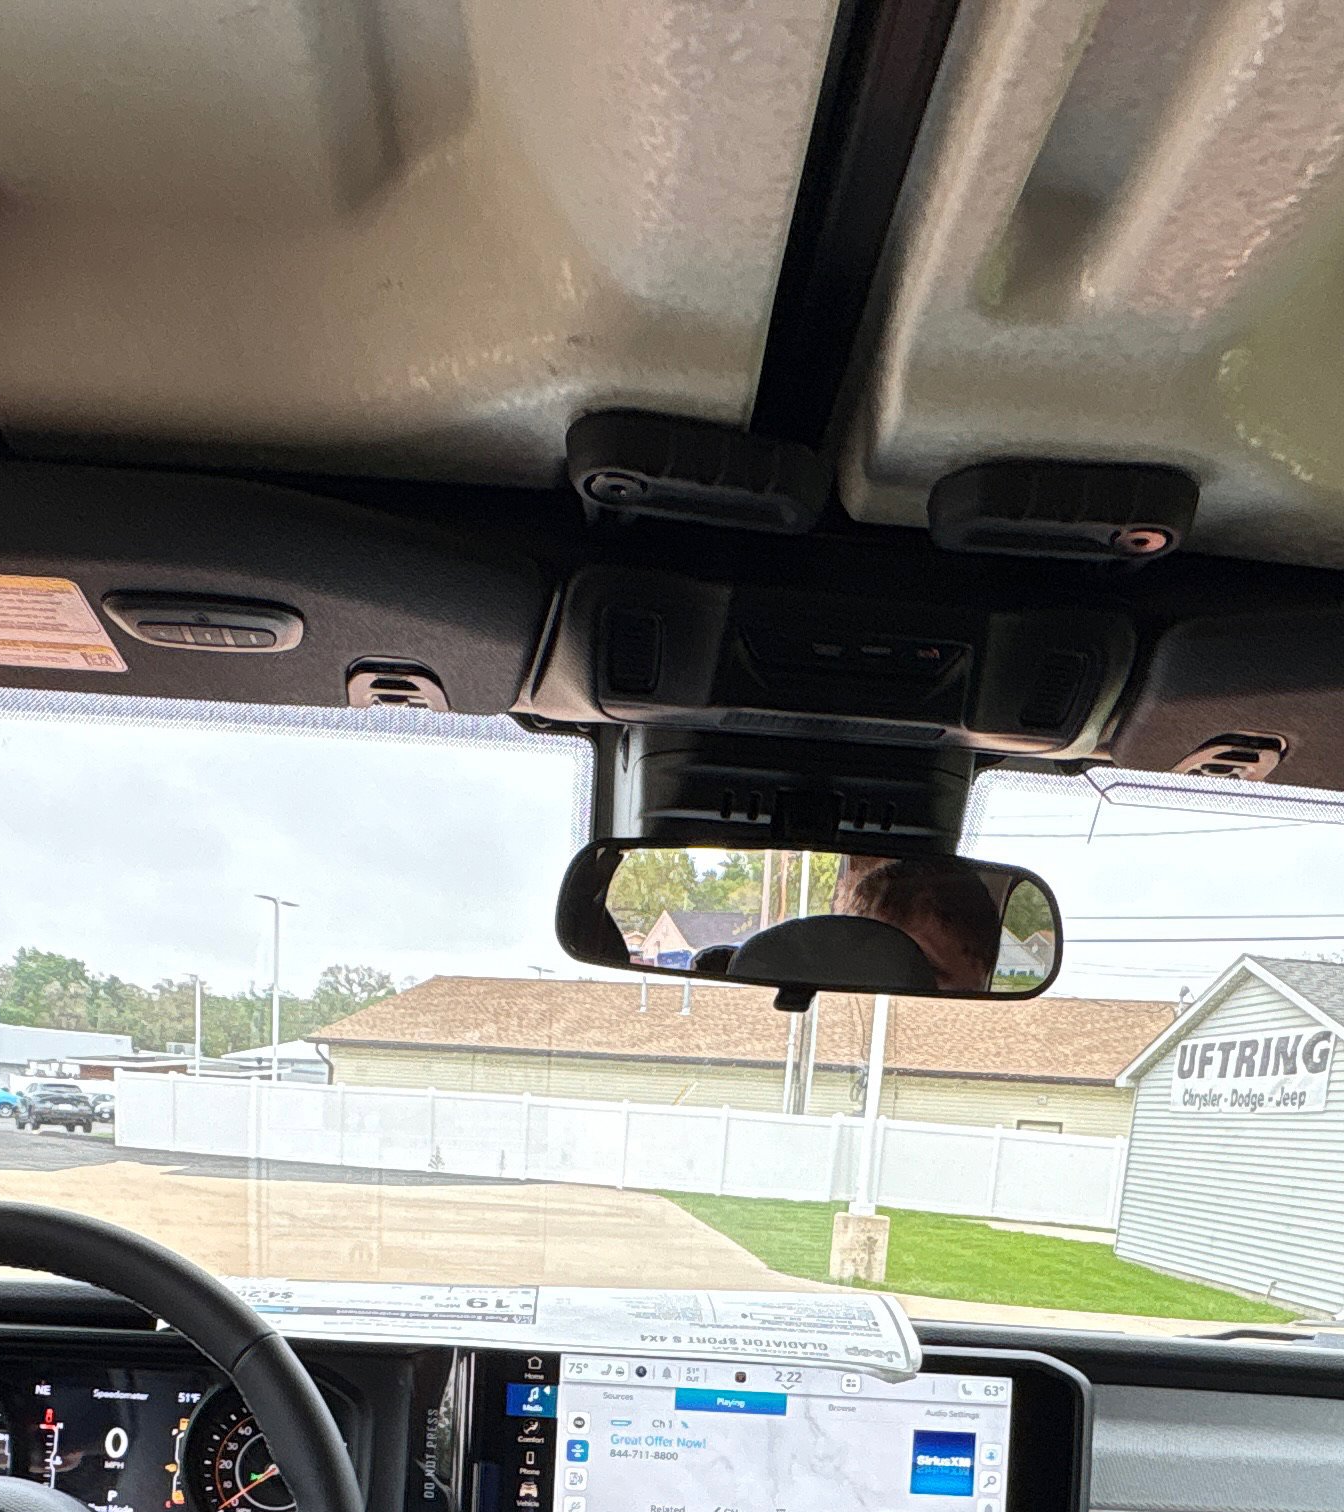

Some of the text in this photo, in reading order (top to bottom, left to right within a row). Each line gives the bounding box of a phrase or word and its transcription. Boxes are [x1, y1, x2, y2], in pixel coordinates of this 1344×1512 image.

[1177, 1030, 1332, 1079] UFTRING
[1182, 1087, 1223, 1111] Chrysler
[1229, 1089, 1265, 1112] Dodge
[1275, 1086, 1306, 1109] Jeep
[466, 1297, 511, 1309] 19
[640, 1333, 829, 1351] GLADIATOR SPORT S 4X4
[845, 1344, 902, 1363] Jeep
[568, 1362, 589, 1376] 75°
[685, 1375, 700, 1383] OUT
[35, 1384, 52, 1396] NE
[92, 1388, 150, 1401] Speedometer
[983, 1385, 1005, 1397] 63°
[602, 1391, 634, 1402] Sources
[716, 1397, 746, 1409] Playing
[828, 1403, 857, 1413] Browse
[925, 1408, 980, 1420] Audio Settings
[651, 1419, 666, 1429] Ch
[237, 1425, 253, 1436] 40
[104, 1426, 129, 1459] 0
[226, 1442, 239, 1451] 30
[610, 1433, 707, 1450] Great Offer Now!
[423, 1408, 439, 1499] DO NOT PRESS
[609, 1448, 679, 1461] 844-711-8800
[103, 1460, 125, 1470] MPH
[219, 1459, 233, 1470] 20
[916, 1454, 972, 1468] SiriusXM
[222, 1480, 233, 1489] 10
[107, 1489, 118, 1502] P
